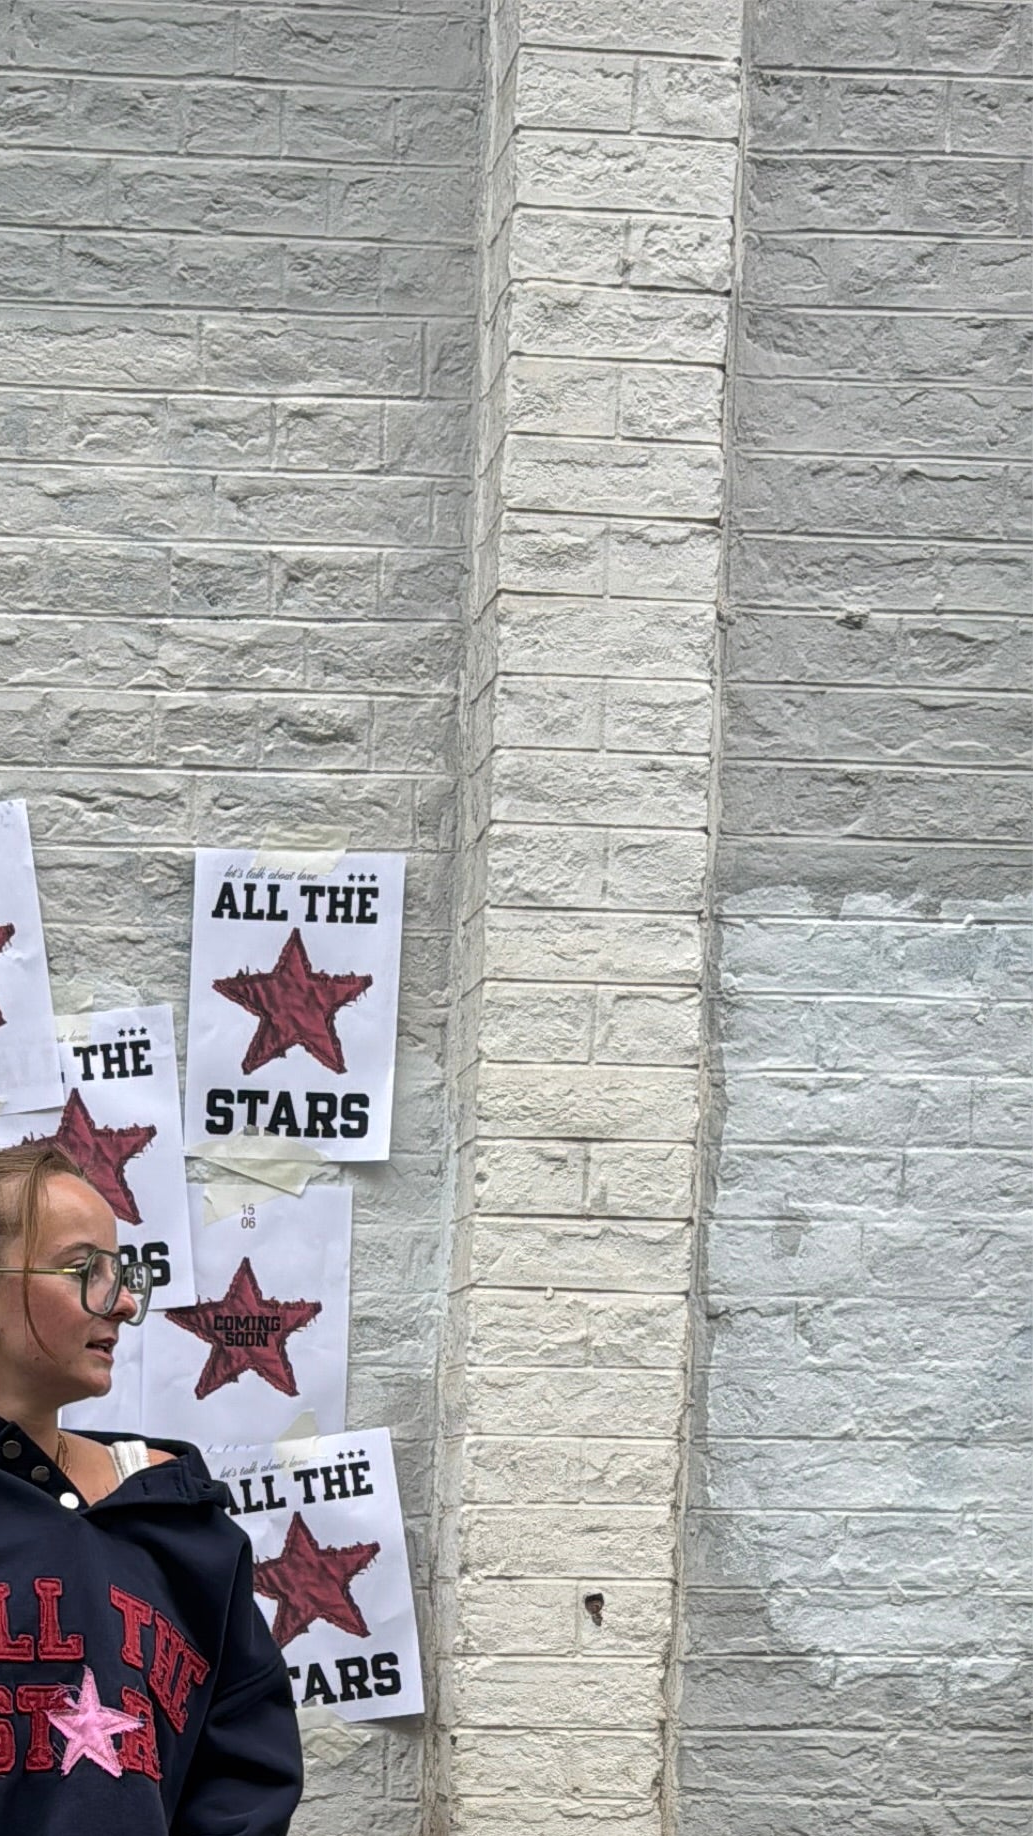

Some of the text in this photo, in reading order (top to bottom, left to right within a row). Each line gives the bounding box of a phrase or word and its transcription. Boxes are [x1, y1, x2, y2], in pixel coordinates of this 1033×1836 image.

[224, 864, 318, 881] let's talk about love
[211, 882, 379, 924] ALL THE
[72, 1039, 153, 1081] THE
[204, 1088, 370, 1139] STARS
[241, 1204, 255, 1216] 15
[241, 1216, 256, 1229] 06
[213, 1315, 281, 1332] COMING
[224, 1331, 268, 1347] SOON
[220, 1455, 309, 1478] let's talk about love
[293, 1460, 374, 1504] THE
